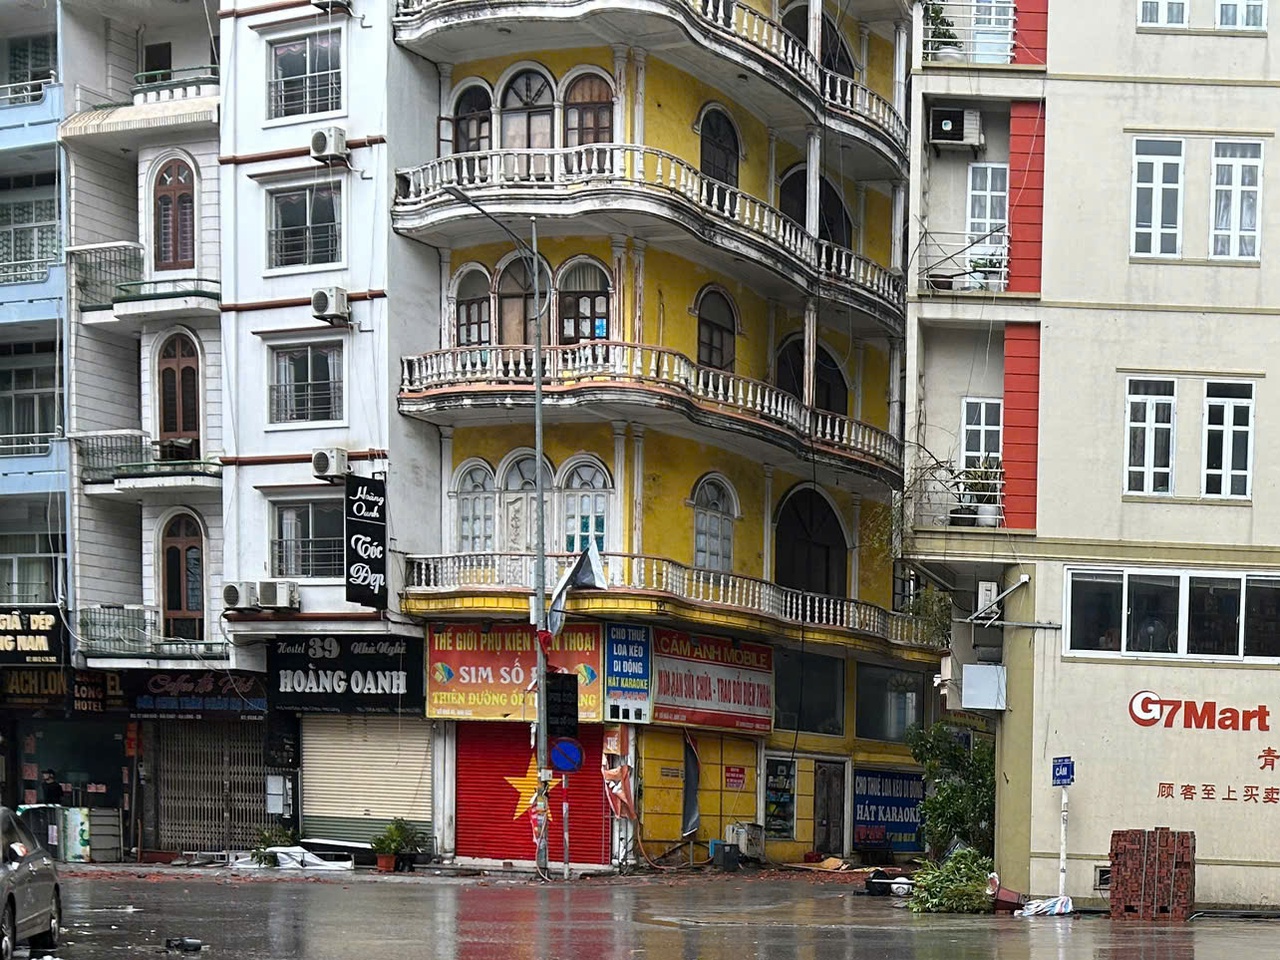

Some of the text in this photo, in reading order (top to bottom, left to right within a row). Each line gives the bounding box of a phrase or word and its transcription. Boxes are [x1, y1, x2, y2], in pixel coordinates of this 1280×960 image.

[349, 485, 385, 506] Hoàng
[350, 534, 384, 559] Tóc
[348, 563, 386, 594] Đẹp
[16, 635, 49, 651] NAM
[455, 628, 477, 651] GIỚI
[611, 626, 646, 641] CHO THUÊ
[276, 641, 305, 654] Hostel
[308, 637, 341, 659] 39
[613, 643, 627, 657] LOA
[722, 646, 769, 669] MOBILE
[279, 662, 408, 695] HOÀNG OANH
[458, 665, 494, 684] SIM
[500, 656, 525, 685] SỐ
[1128, 690, 1271, 732] G7Mart
[856, 800, 877, 821] HÁT
